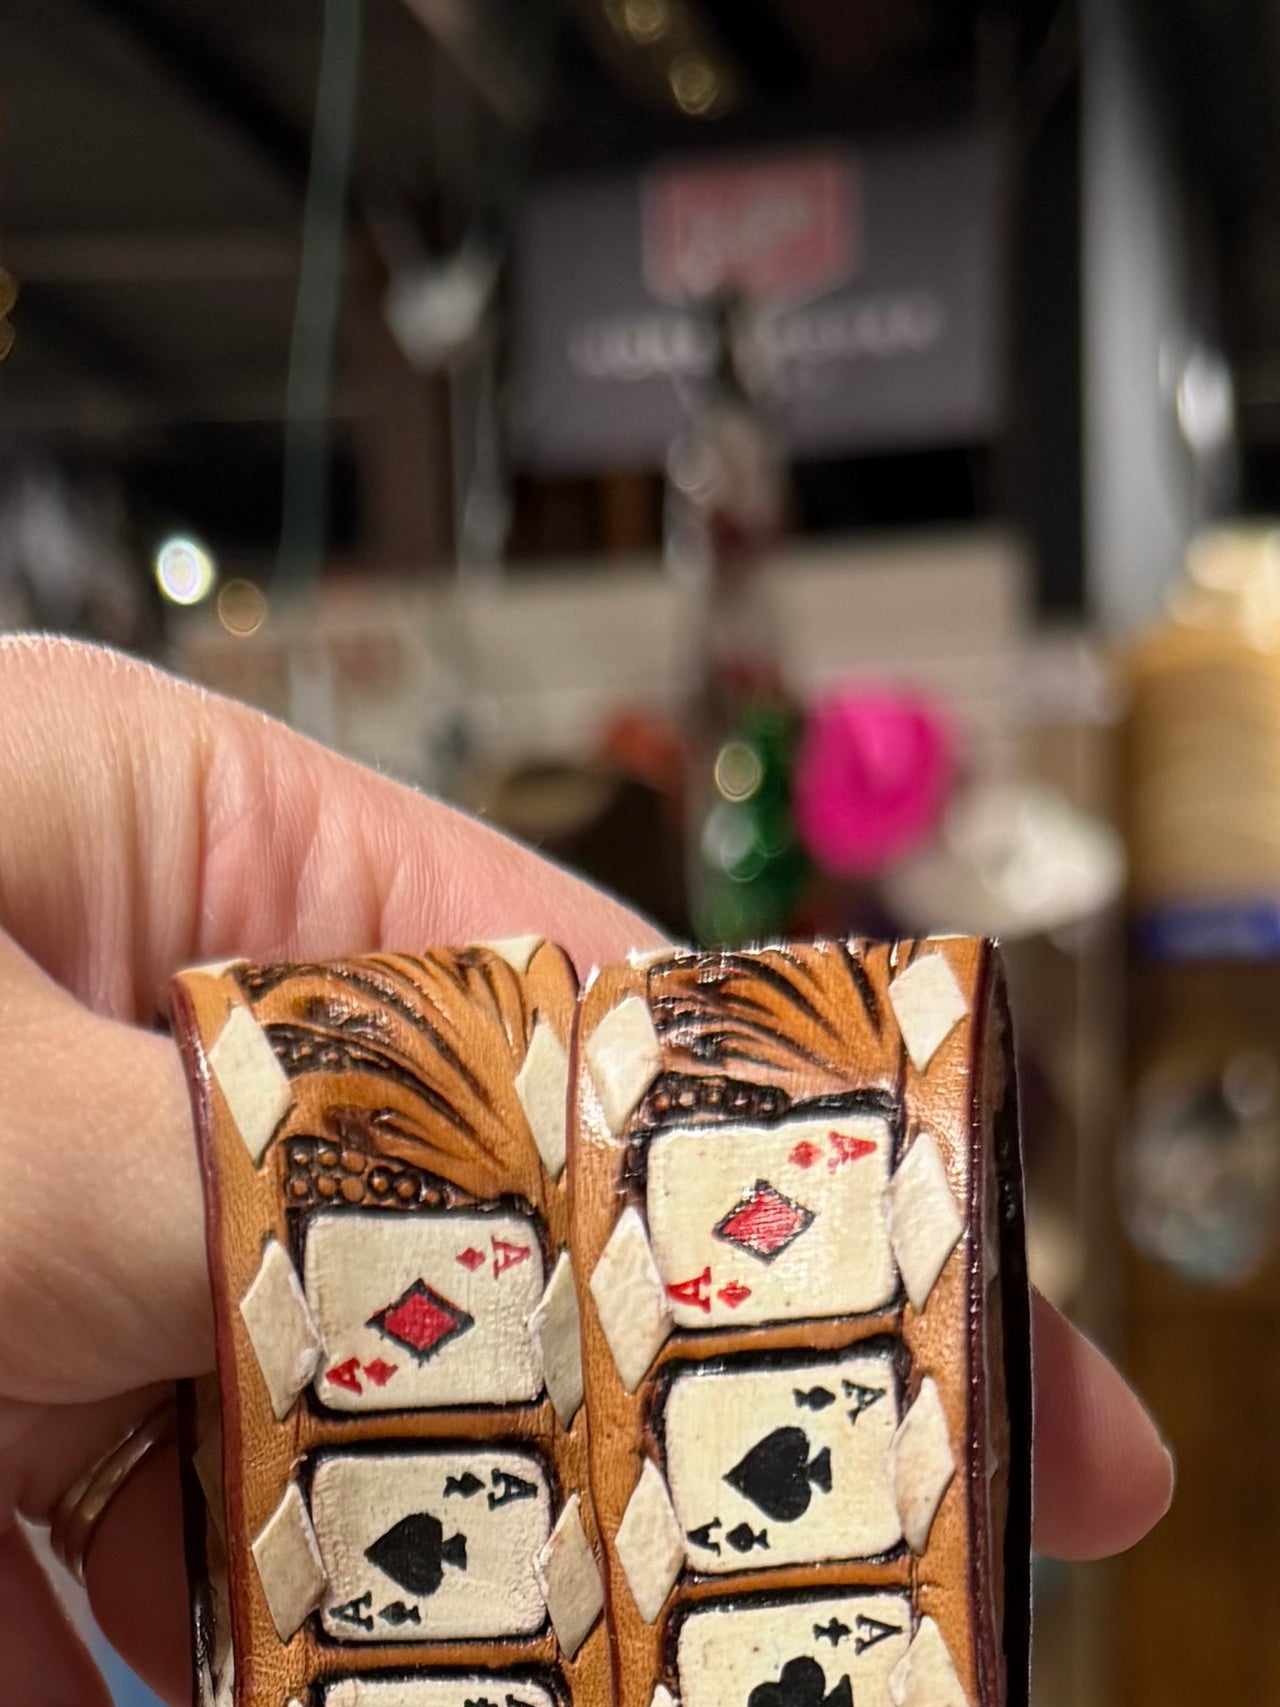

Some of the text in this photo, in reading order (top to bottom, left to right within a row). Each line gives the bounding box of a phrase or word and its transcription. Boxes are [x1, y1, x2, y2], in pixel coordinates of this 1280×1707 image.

[827, 1132, 877, 1173] A
[488, 1236, 530, 1279] A
[667, 1267, 711, 1313] A
[325, 1357, 363, 1396] A
[841, 1380, 886, 1425] A
[488, 1468, 538, 1510] A
[687, 1517, 722, 1556] A
[330, 1591, 375, 1632] A
[855, 1614, 902, 1655] A
